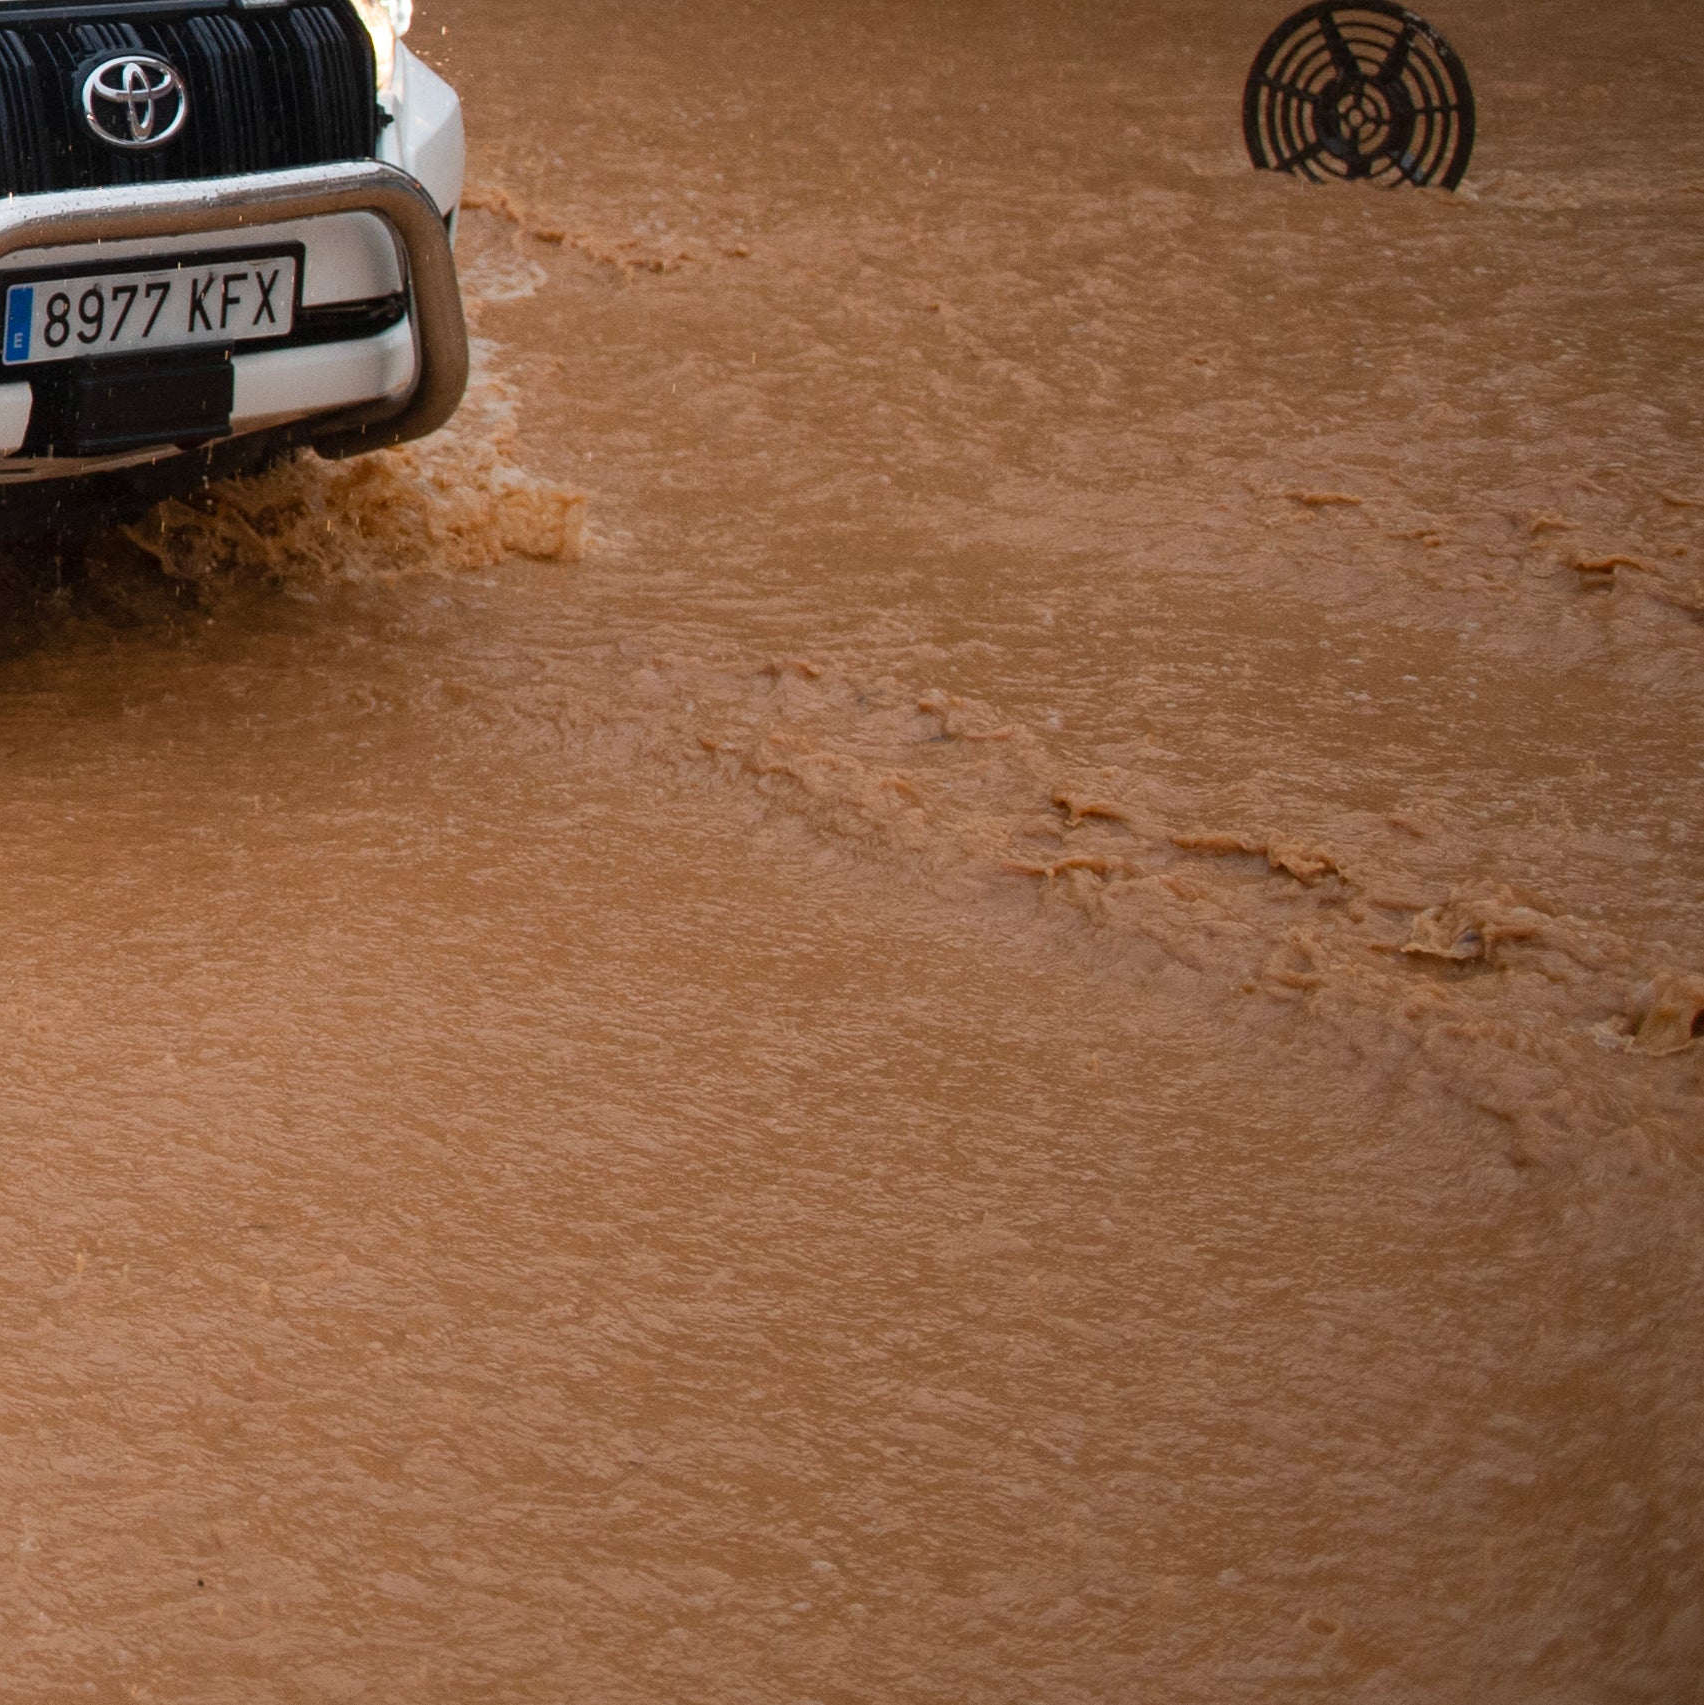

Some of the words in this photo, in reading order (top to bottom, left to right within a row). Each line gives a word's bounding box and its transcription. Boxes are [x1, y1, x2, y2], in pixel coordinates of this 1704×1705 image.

[13, 332, 23, 348] E
[43, 281, 171, 348] 8977
[187, 269, 280, 333] KFX
